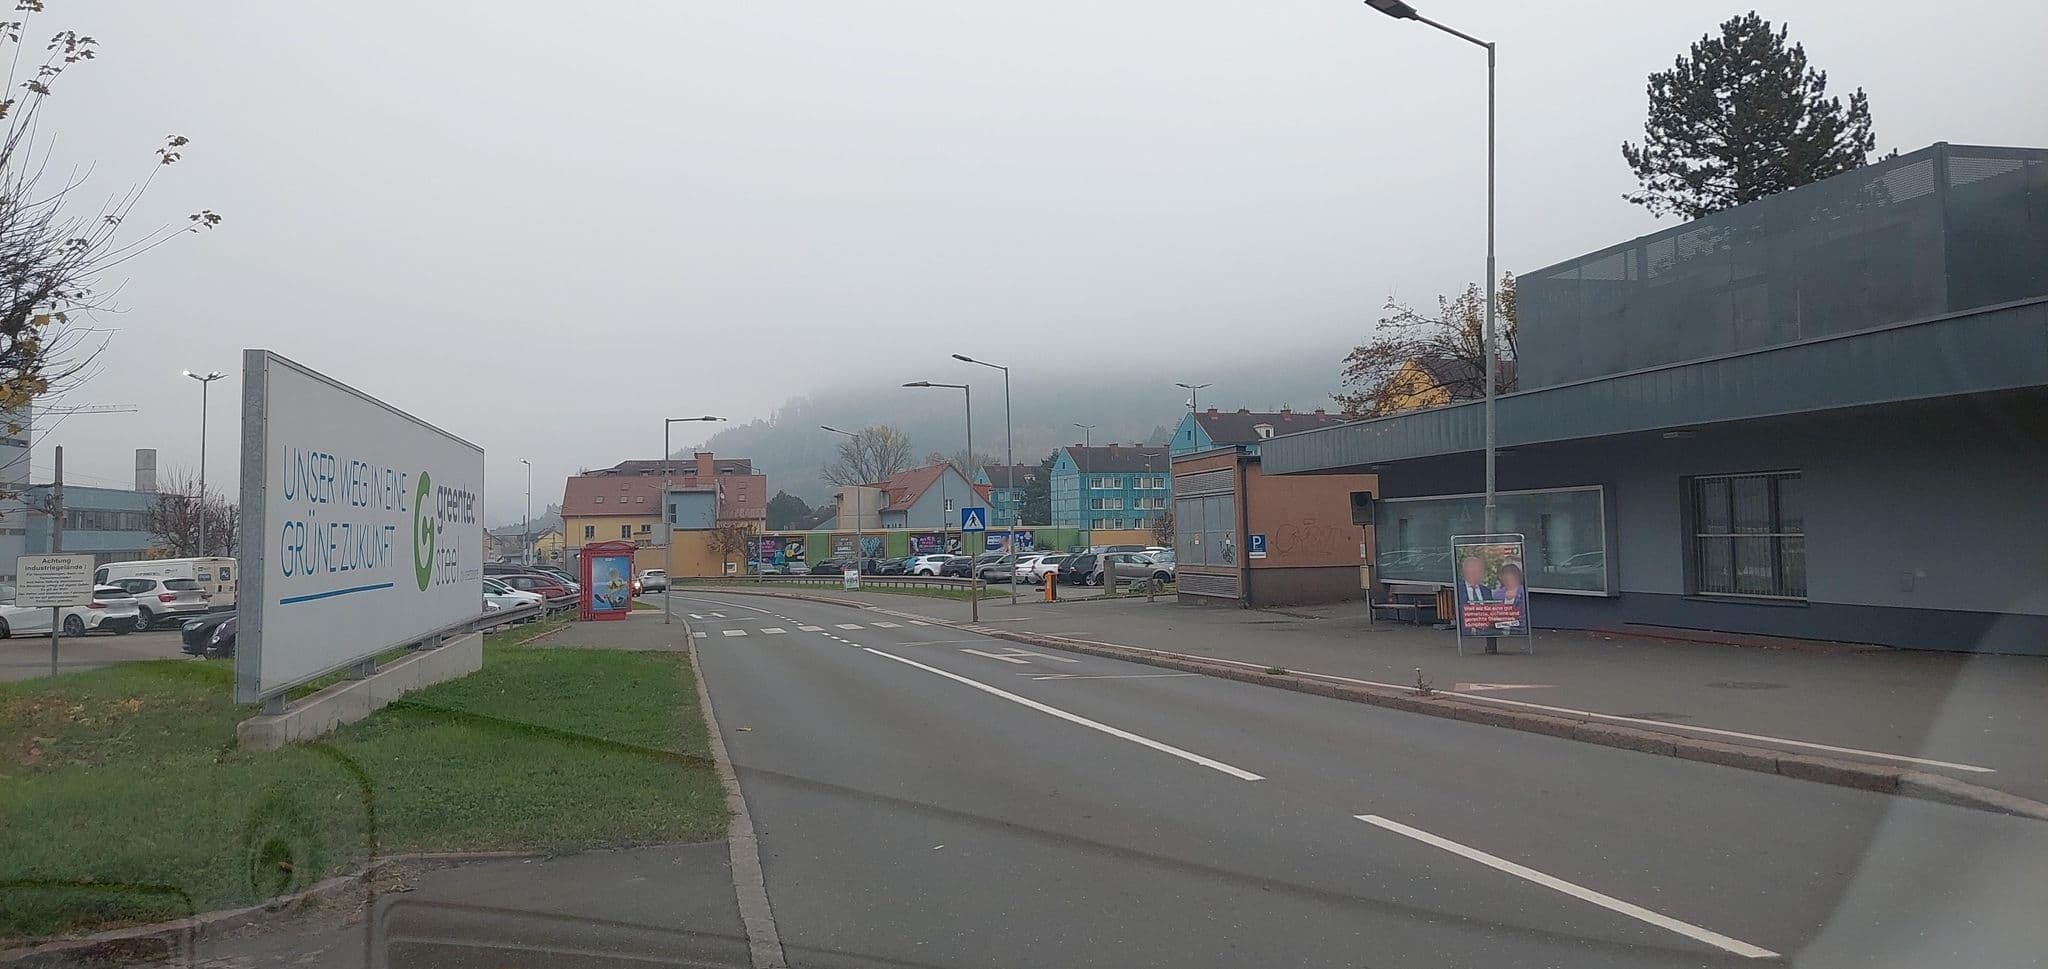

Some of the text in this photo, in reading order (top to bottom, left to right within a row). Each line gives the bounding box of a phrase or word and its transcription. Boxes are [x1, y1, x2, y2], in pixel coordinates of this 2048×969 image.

[282, 445, 407, 512] UNSER WEG IN EINE
[437, 482, 476, 535] greentec
[280, 509, 395, 577] GRÜNE ZUKUNFT
[436, 536, 460, 586] steel
[1252, 535, 1262, 550] P
